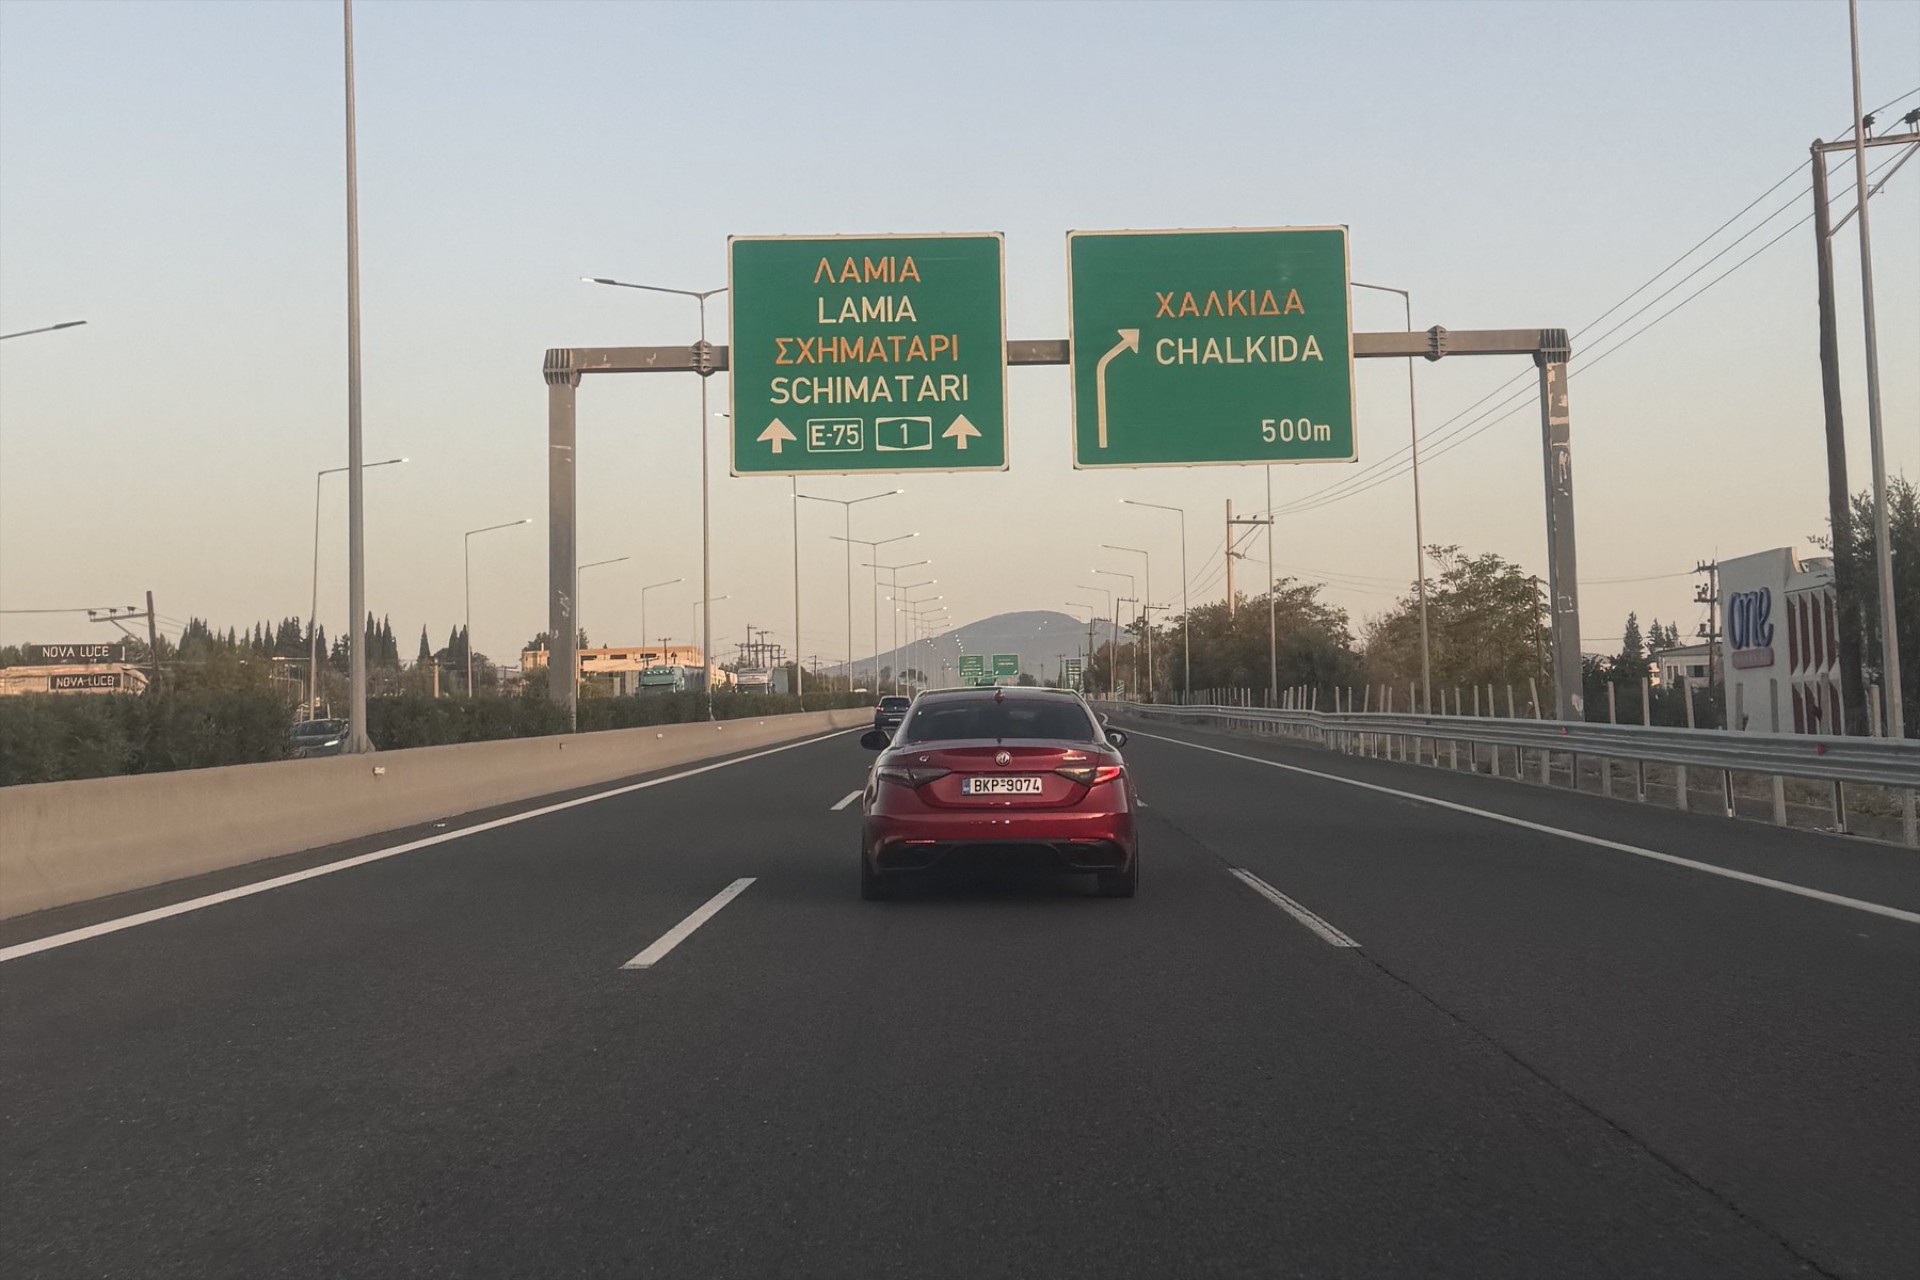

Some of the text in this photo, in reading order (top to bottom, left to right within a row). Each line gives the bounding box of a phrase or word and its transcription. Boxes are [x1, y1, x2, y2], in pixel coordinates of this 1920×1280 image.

[813, 256, 921, 284] ΛΑΜΙΑ
[818, 295, 917, 324] LAMIA
[1155, 288, 1305, 318] ΧΑΛΚΙΔΑ
[775, 334, 959, 365] ΣΧΗΜΑΤΑΡΙ
[1155, 335, 1324, 365] CHALKIDA
[770, 373, 968, 404] SCHIMATARI
[810, 424, 860, 447] E-75
[900, 422, 909, 445] 1
[1261, 418, 1331, 443] 500m
[42, 645, 109, 658] NOVA LUCE
[56, 676, 84, 688] NOVA
